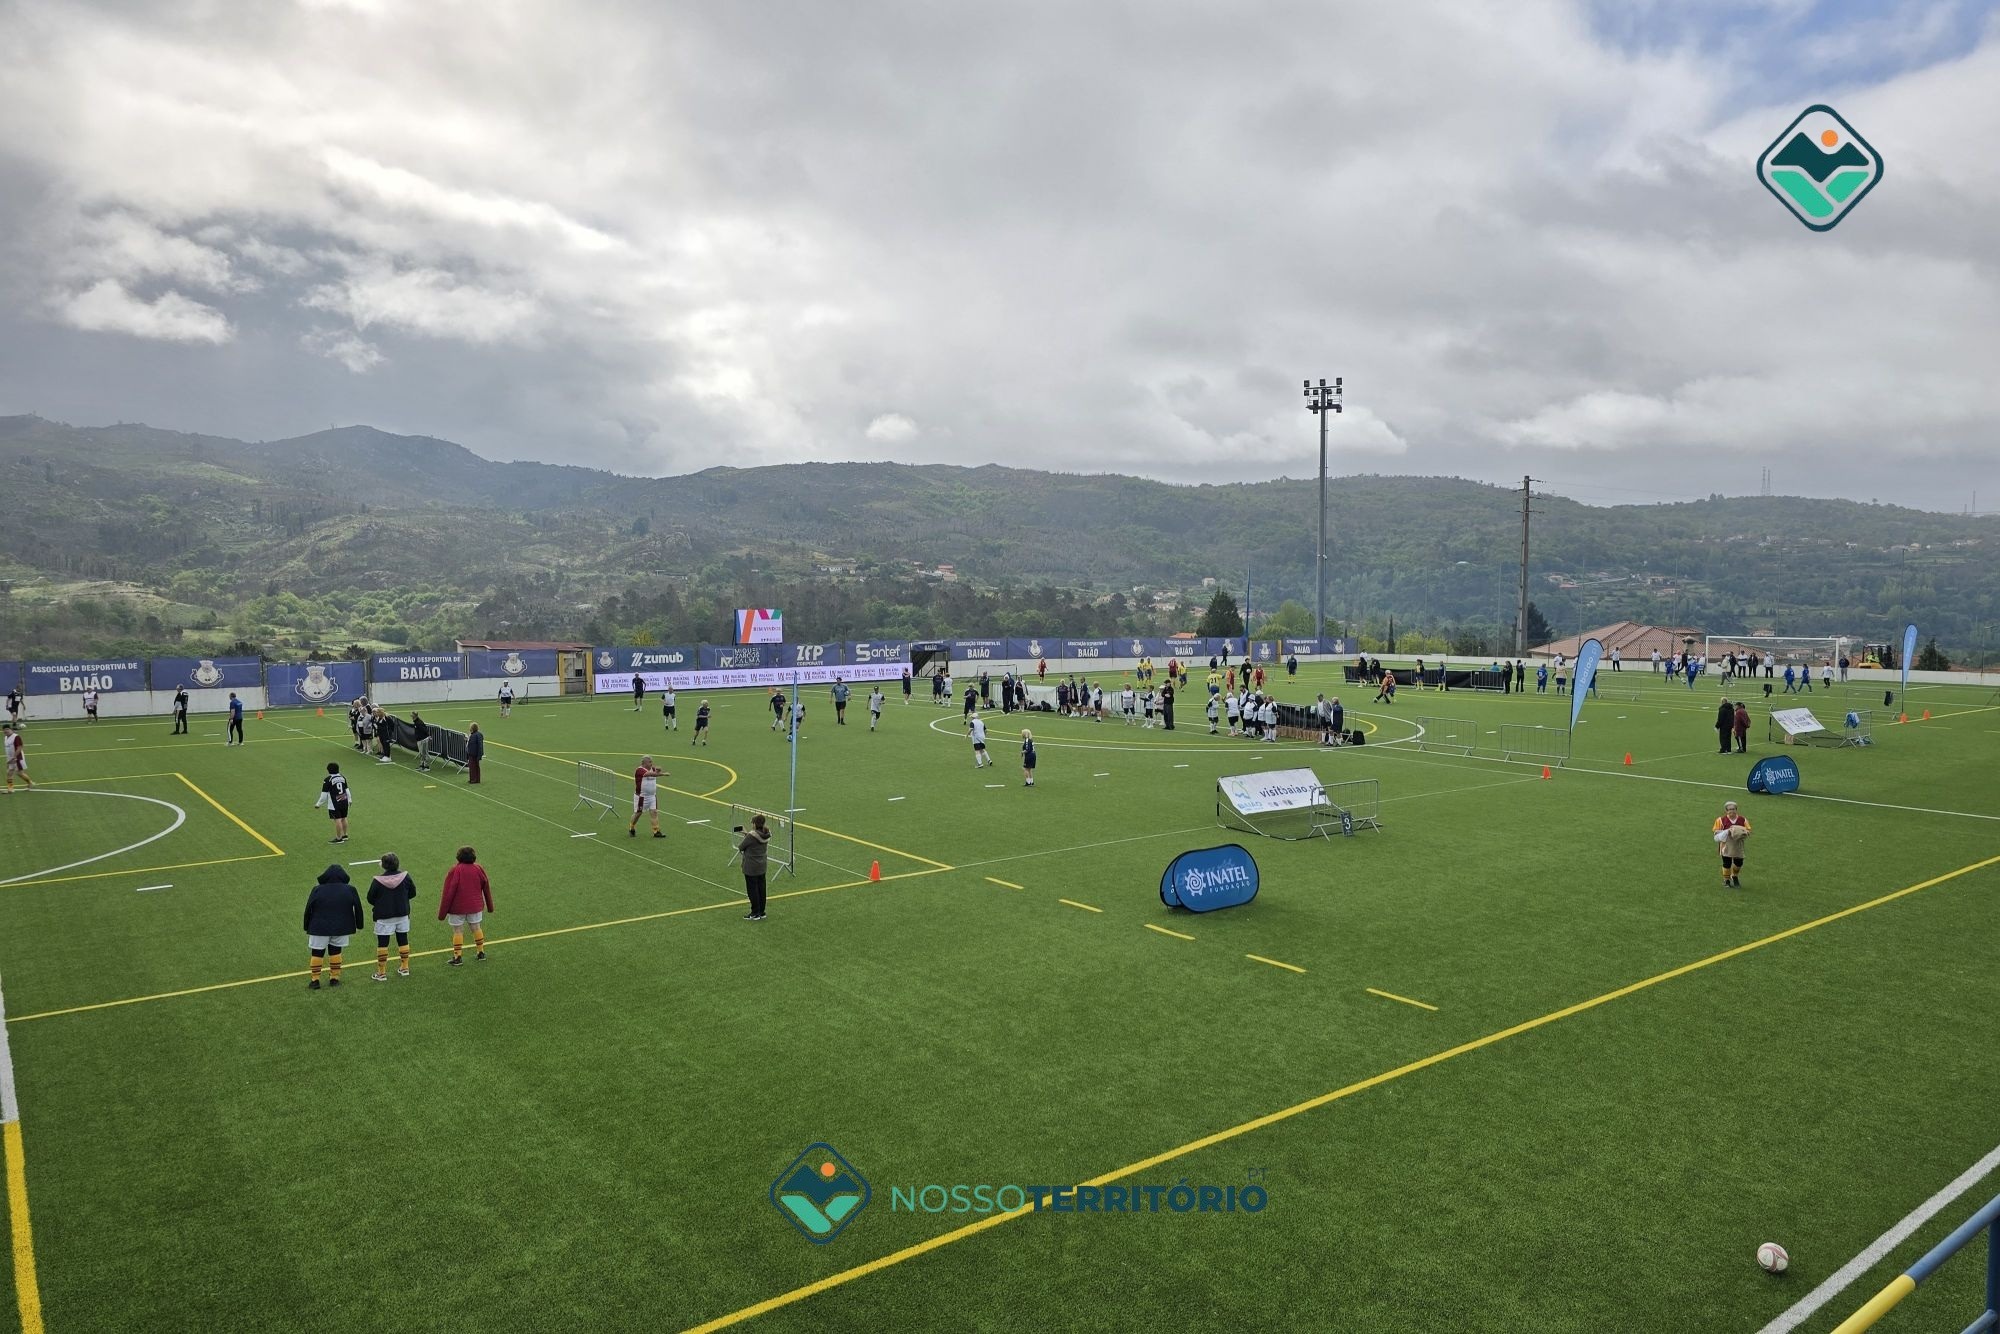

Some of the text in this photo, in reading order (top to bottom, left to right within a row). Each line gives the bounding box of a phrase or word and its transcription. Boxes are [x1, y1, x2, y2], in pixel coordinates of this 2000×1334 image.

[967, 647, 990, 659] BAIÃO
[1078, 646, 1099, 658] BAIÃO
[1174, 645, 1194, 656] BAIÃO
[378, 656, 416, 665] ASSOCIAÇÃO
[416, 656, 453, 664] DESPORTIVA
[644, 652, 684, 665] zumub
[31, 662, 138, 674] ASSOCIAÇÃO DESPORTIVA DE
[400, 664, 442, 680] BAIÃO
[59, 673, 113, 692] BAIÃO
[336, 782, 343, 795] 9
[1344, 817, 1351, 830] 3
[1205, 865, 1249, 887] INATEL
[1209, 880, 1251, 894] FUNDAÇÃO
